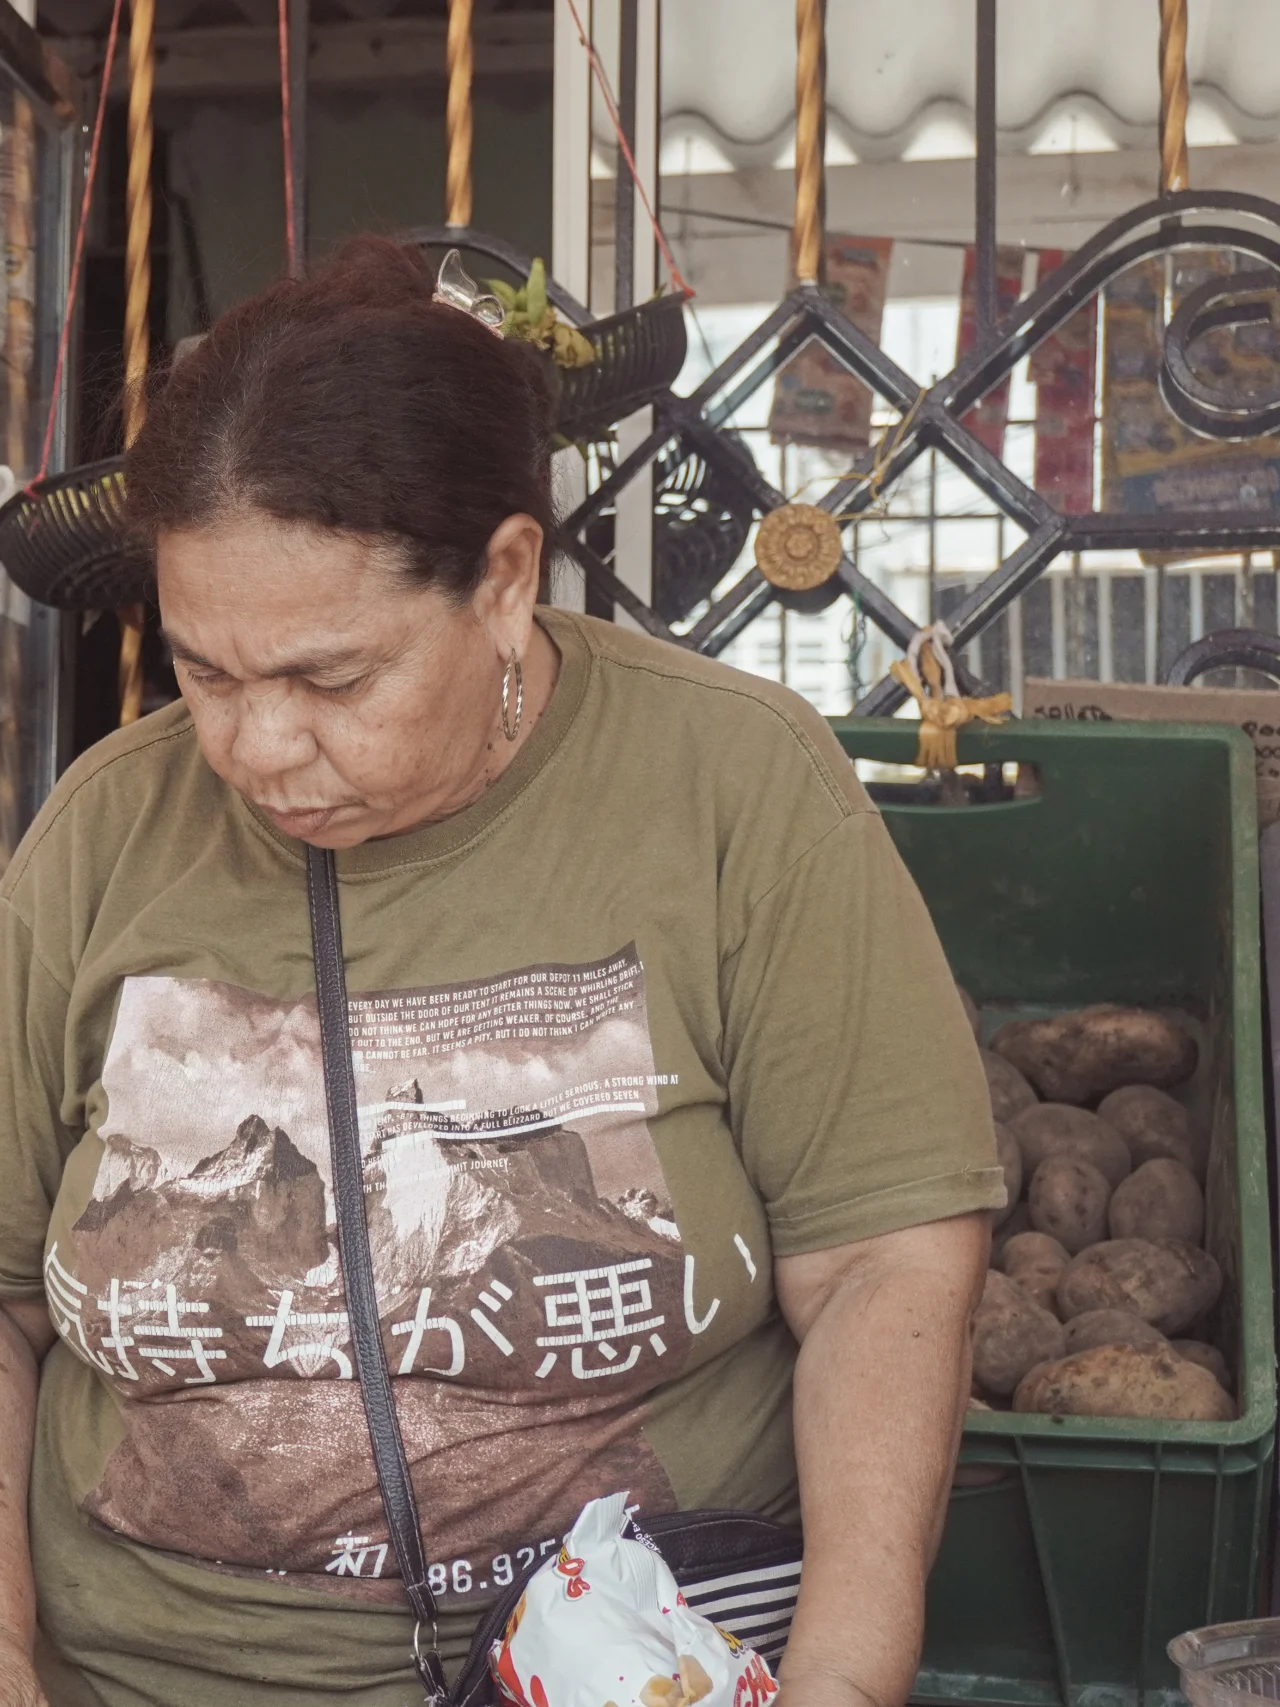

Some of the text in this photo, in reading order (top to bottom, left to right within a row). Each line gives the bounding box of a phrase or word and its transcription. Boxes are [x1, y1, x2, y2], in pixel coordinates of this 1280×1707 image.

[348, 1000, 372, 1011] EVERY
[375, 999, 389, 1009] DAY
[392, 998, 403, 1008] WE
[406, 996, 426, 1007] HAVE
[430, 993, 449, 1004] BEEN
[453, 989, 477, 1001] READY
[480, 986, 488, 996] TO
[490, 980, 511, 994] START
[513, 976, 529, 986] FOR
[531, 973, 547, 983] OUR
[550, 972, 570, 983] DEPOT
[583, 969, 606, 981] MILES
[348, 1014, 363, 1024] BUT
[366, 1011, 398, 1022] OUTSIDE
[400, 1010, 415, 1020] THE
[418, 1008, 439, 1019] DOOR
[441, 1005, 451, 1014] OF
[454, 1002, 469, 1014] OUR
[471, 998, 490, 1010] TENT
[492, 995, 498, 1004] IT
[500, 987, 535, 1001] REMAINS
[537, 986, 543, 996] A
[544, 986, 566, 997] SCENE
[568, 986, 578, 996] OF
[580, 976, 618, 994] WHIRLING
[620, 966, 641, 981] DRIFT.
[349, 1028, 359, 1036] DO
[362, 1026, 377, 1036] NOT
[380, 1024, 403, 1035] THINK
[406, 1023, 417, 1033] WE
[420, 1021, 436, 1031] CAN
[438, 1018, 459, 1028] HOPE
[461, 1014, 476, 1025] FOR
[477, 1010, 492, 1021] ANY
[493, 1001, 521, 1015] BETTER
[524, 998, 552, 1009] THINGS
[575, 997, 587, 1008] WE
[589, 990, 611, 1003] SHALL
[613, 980, 634, 994] STICK
[357, 1038, 373, 1047] OUT
[376, 1038, 386, 1048] TO
[388, 1037, 402, 1048] THE
[426, 1032, 440, 1043] BUT
[443, 1030, 455, 1040] WE
[457, 1026, 471, 1037] ARE
[473, 1017, 504, 1033] GETTING
[544, 1013, 554, 1022] OF
[590, 1003, 605, 1015] AND
[606, 995, 620, 1007] THE
[366, 1050, 398, 1060] CANNOT
[401, 1049, 410, 1058] BE
[413, 1046, 431, 1057] FAR.
[432, 1045, 440, 1054] IT
[441, 1039, 466, 1052] SEEMS
[467, 1037, 472, 1045] A
[495, 1028, 510, 1039] BUT
[519, 1028, 530, 1037] DO
[533, 1027, 547, 1036] NOT
[549, 1025, 573, 1036] THINK
[580, 1017, 594, 1030] CAN
[596, 1006, 616, 1022] WRITE
[619, 1000, 635, 1011] ANY
[419, 1113, 449, 1123] THINGS
[450, 1111, 495, 1122] BEGINNING
[497, 1109, 508, 1117] TO
[510, 1104, 531, 1116] LOOK
[533, 1103, 537, 1111] A
[540, 1093, 563, 1109] LITTLE
[604, 1078, 610, 1088] A
[611, 1075, 644, 1088] STRONG
[646, 1075, 668, 1085] WIND
[670, 1074, 679, 1084] AT
[451, 1122, 470, 1131] INTO
[473, 1123, 478, 1131] A
[479, 1120, 500, 1131] FULL
[503, 1113, 541, 1127] BLIZZARD
[543, 1109, 557, 1120] BUT
[560, 1103, 571, 1113] WE
[573, 1093, 611, 1108] COVERED
[613, 1090, 639, 1101] SEVEN
[471, 1158, 512, 1170] JOURNEY.
